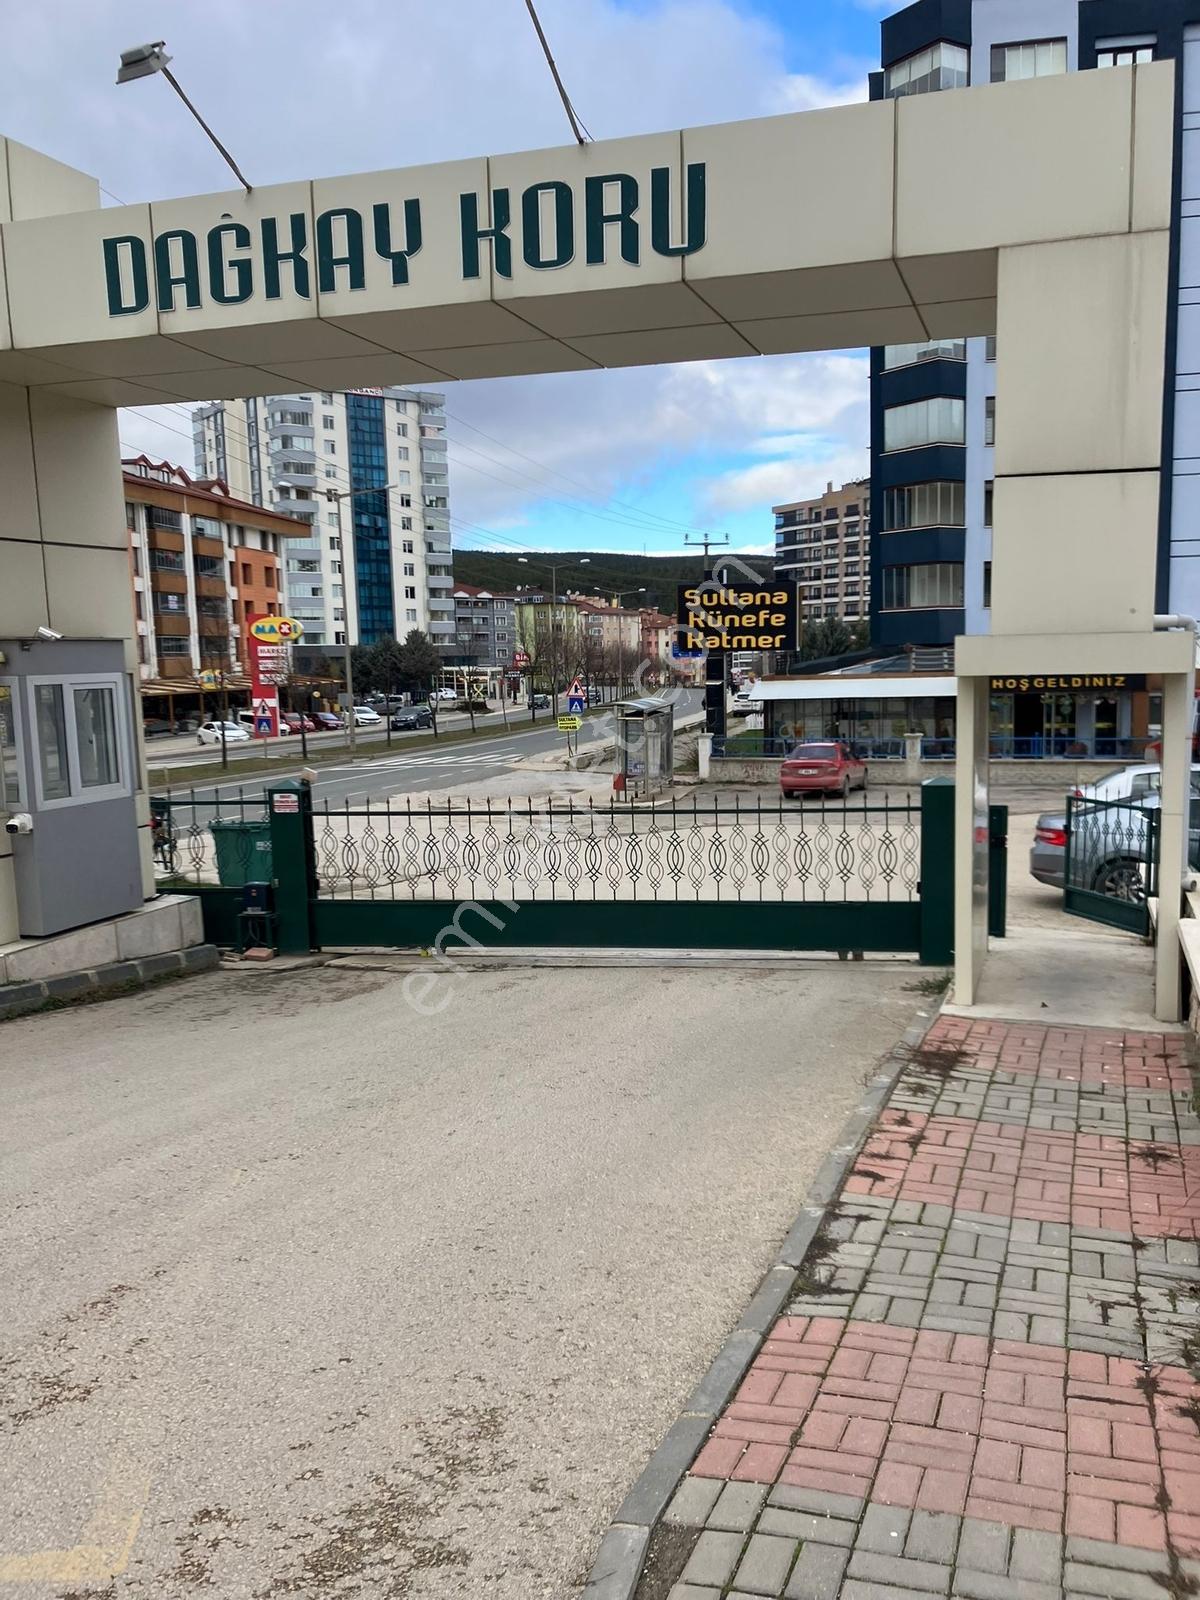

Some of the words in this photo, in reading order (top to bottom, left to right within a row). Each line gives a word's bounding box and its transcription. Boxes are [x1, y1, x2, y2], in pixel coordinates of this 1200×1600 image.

[103, 199, 422, 318] DAĞKAY
[460, 162, 707, 281] KORU
[684, 588, 789, 607] Sultana
[688, 610, 787, 628] Künefe
[686, 632, 787, 649] Katmer
